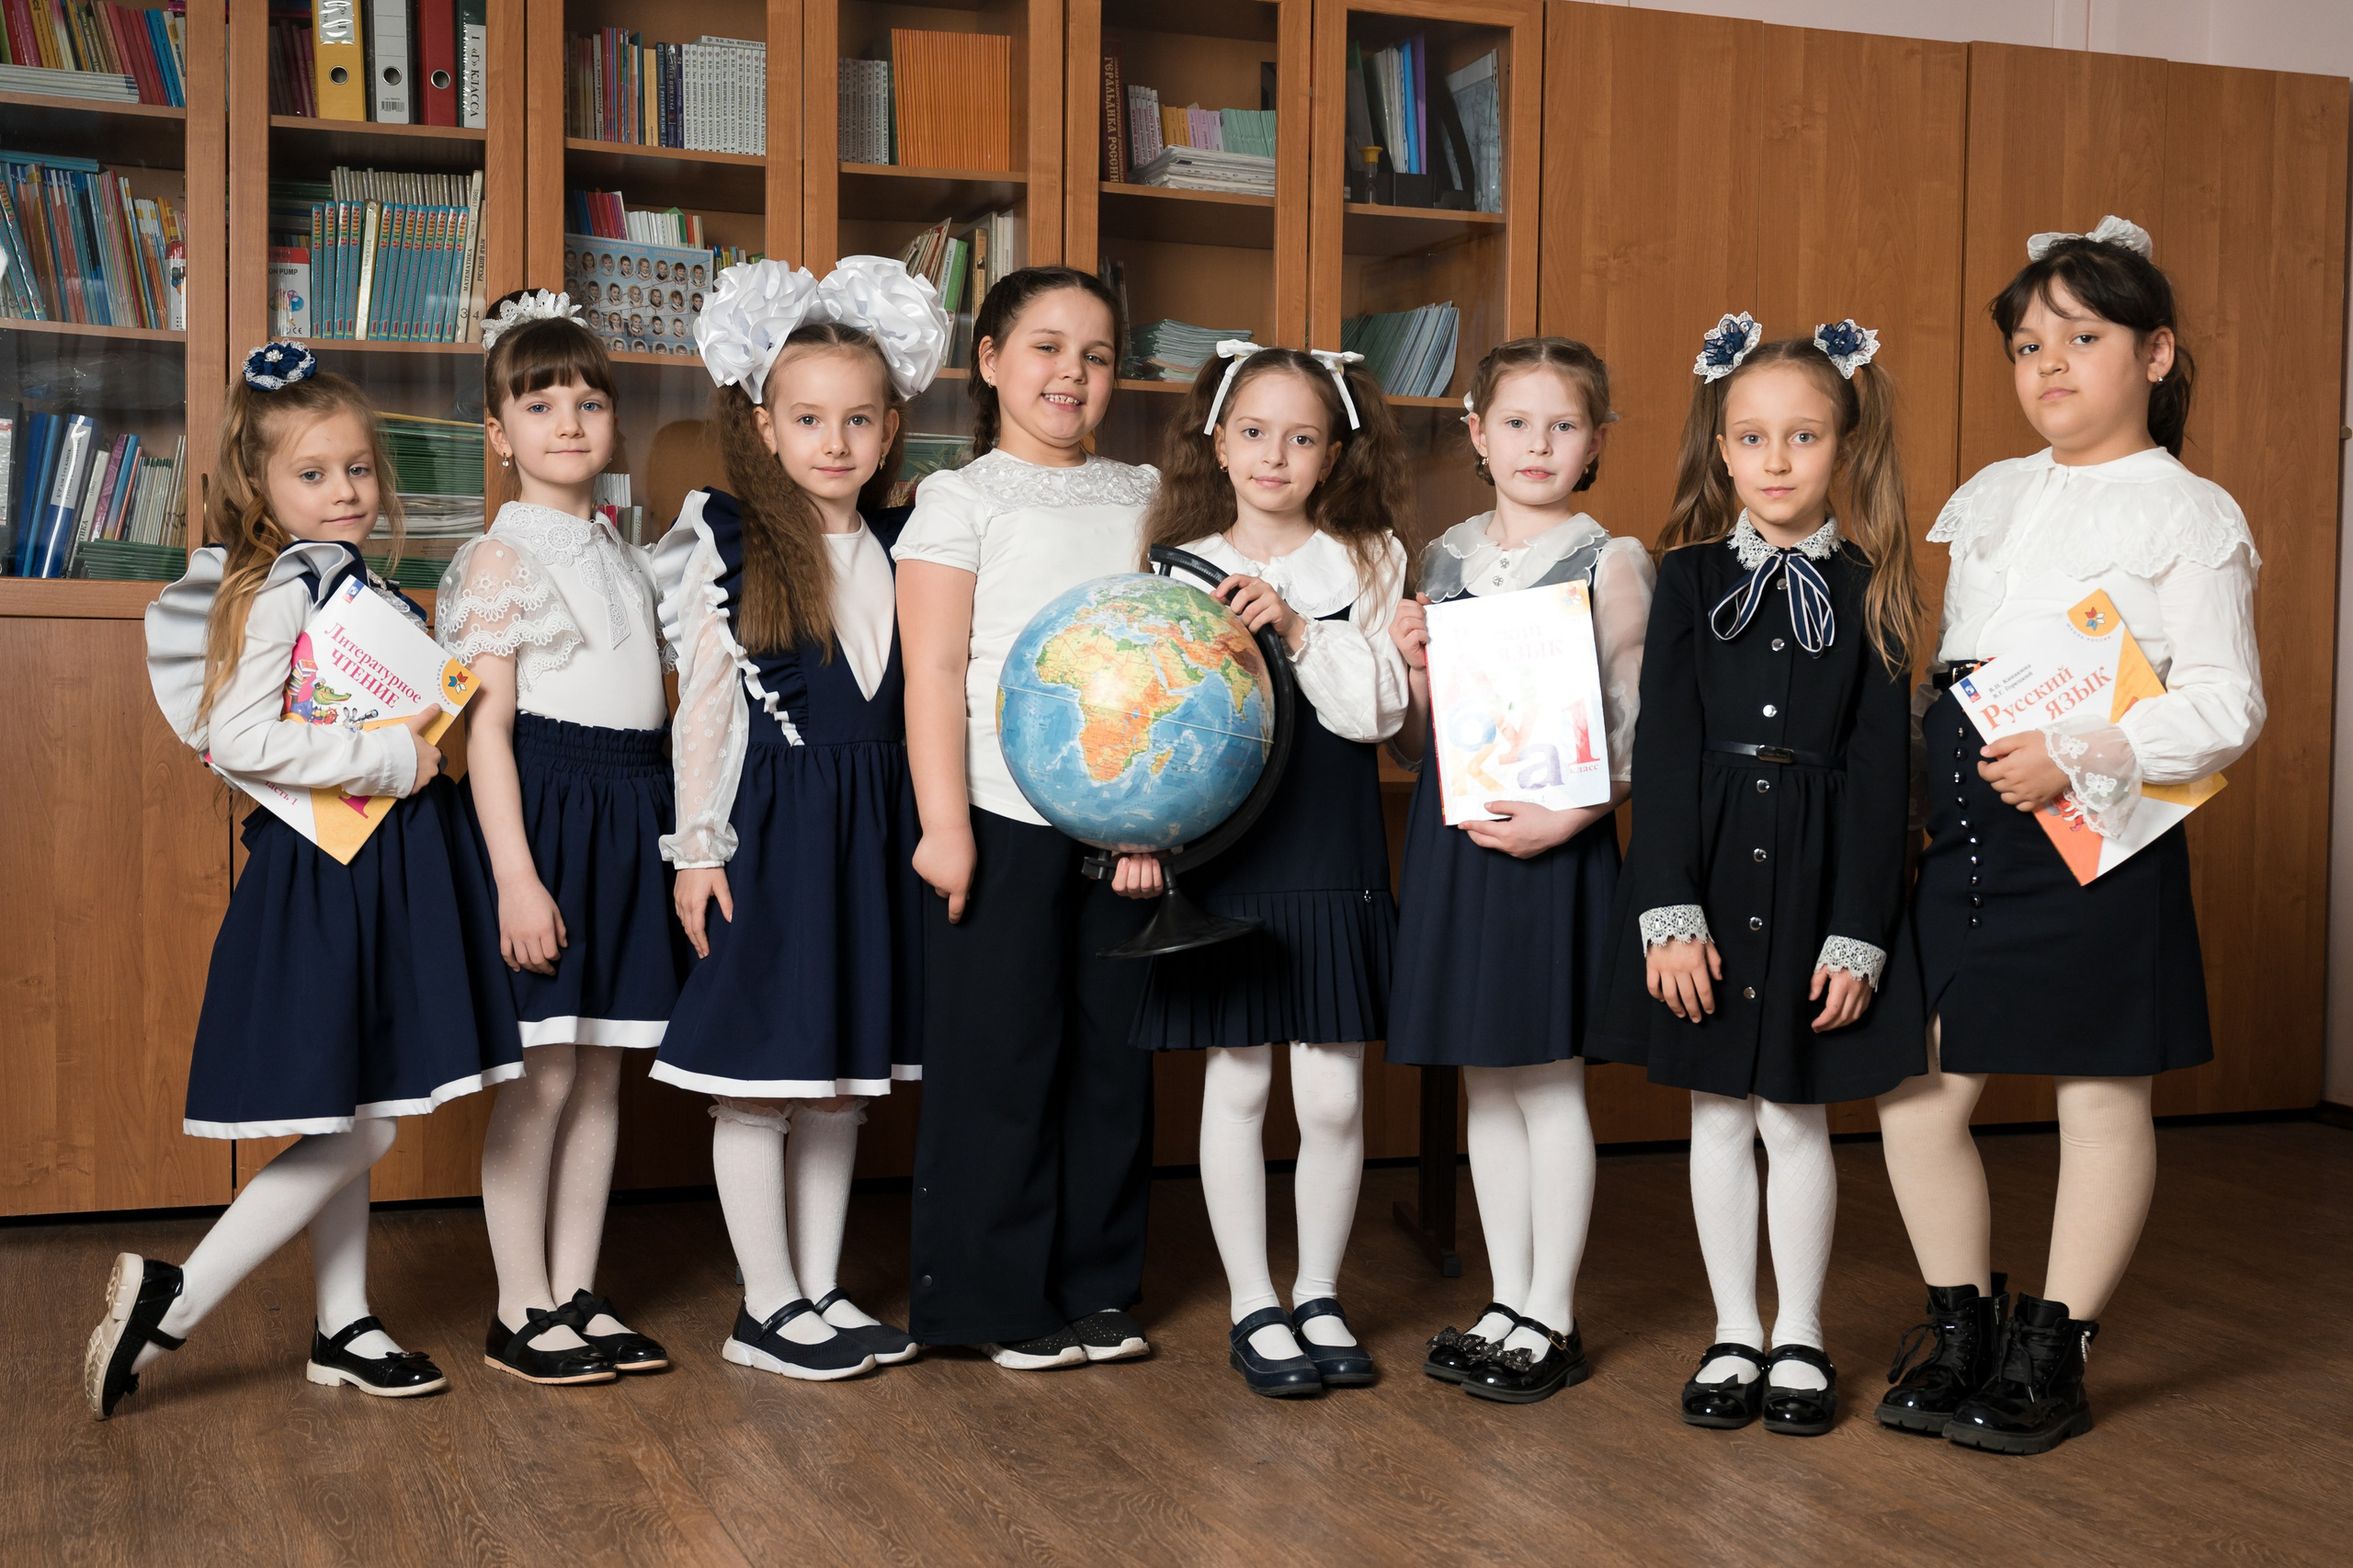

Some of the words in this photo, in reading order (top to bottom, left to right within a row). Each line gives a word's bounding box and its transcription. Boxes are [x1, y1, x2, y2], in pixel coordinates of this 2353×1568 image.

[471, 48, 479, 66] «Г»
[470, 69, 479, 117] КЛАССА
[1104, 56, 1116, 132] ГЕРАЛЬДИКА
[1133, 136, 1138, 144] ПО
[1109, 136, 1119, 182] РОССИИ
[463, 248, 472, 292] МАТЕМАТИКА
[942, 261, 950, 285] СНЕЖНЫЙ
[460, 308, 468, 319] 3
[472, 310, 480, 320] 4
[1453, 621, 1546, 648] Рский
[324, 621, 421, 704] Литературное
[2002, 664, 2032, 684] Канакина
[331, 648, 399, 708] ЧТЕНИЕ
[2005, 671, 2033, 692] Горецкий
[1980, 665, 2075, 731] Русский
[2045, 666, 2112, 721] ЯЗЫК
[1569, 763, 1599, 775] класс
[291, 798, 298, 806] 1
